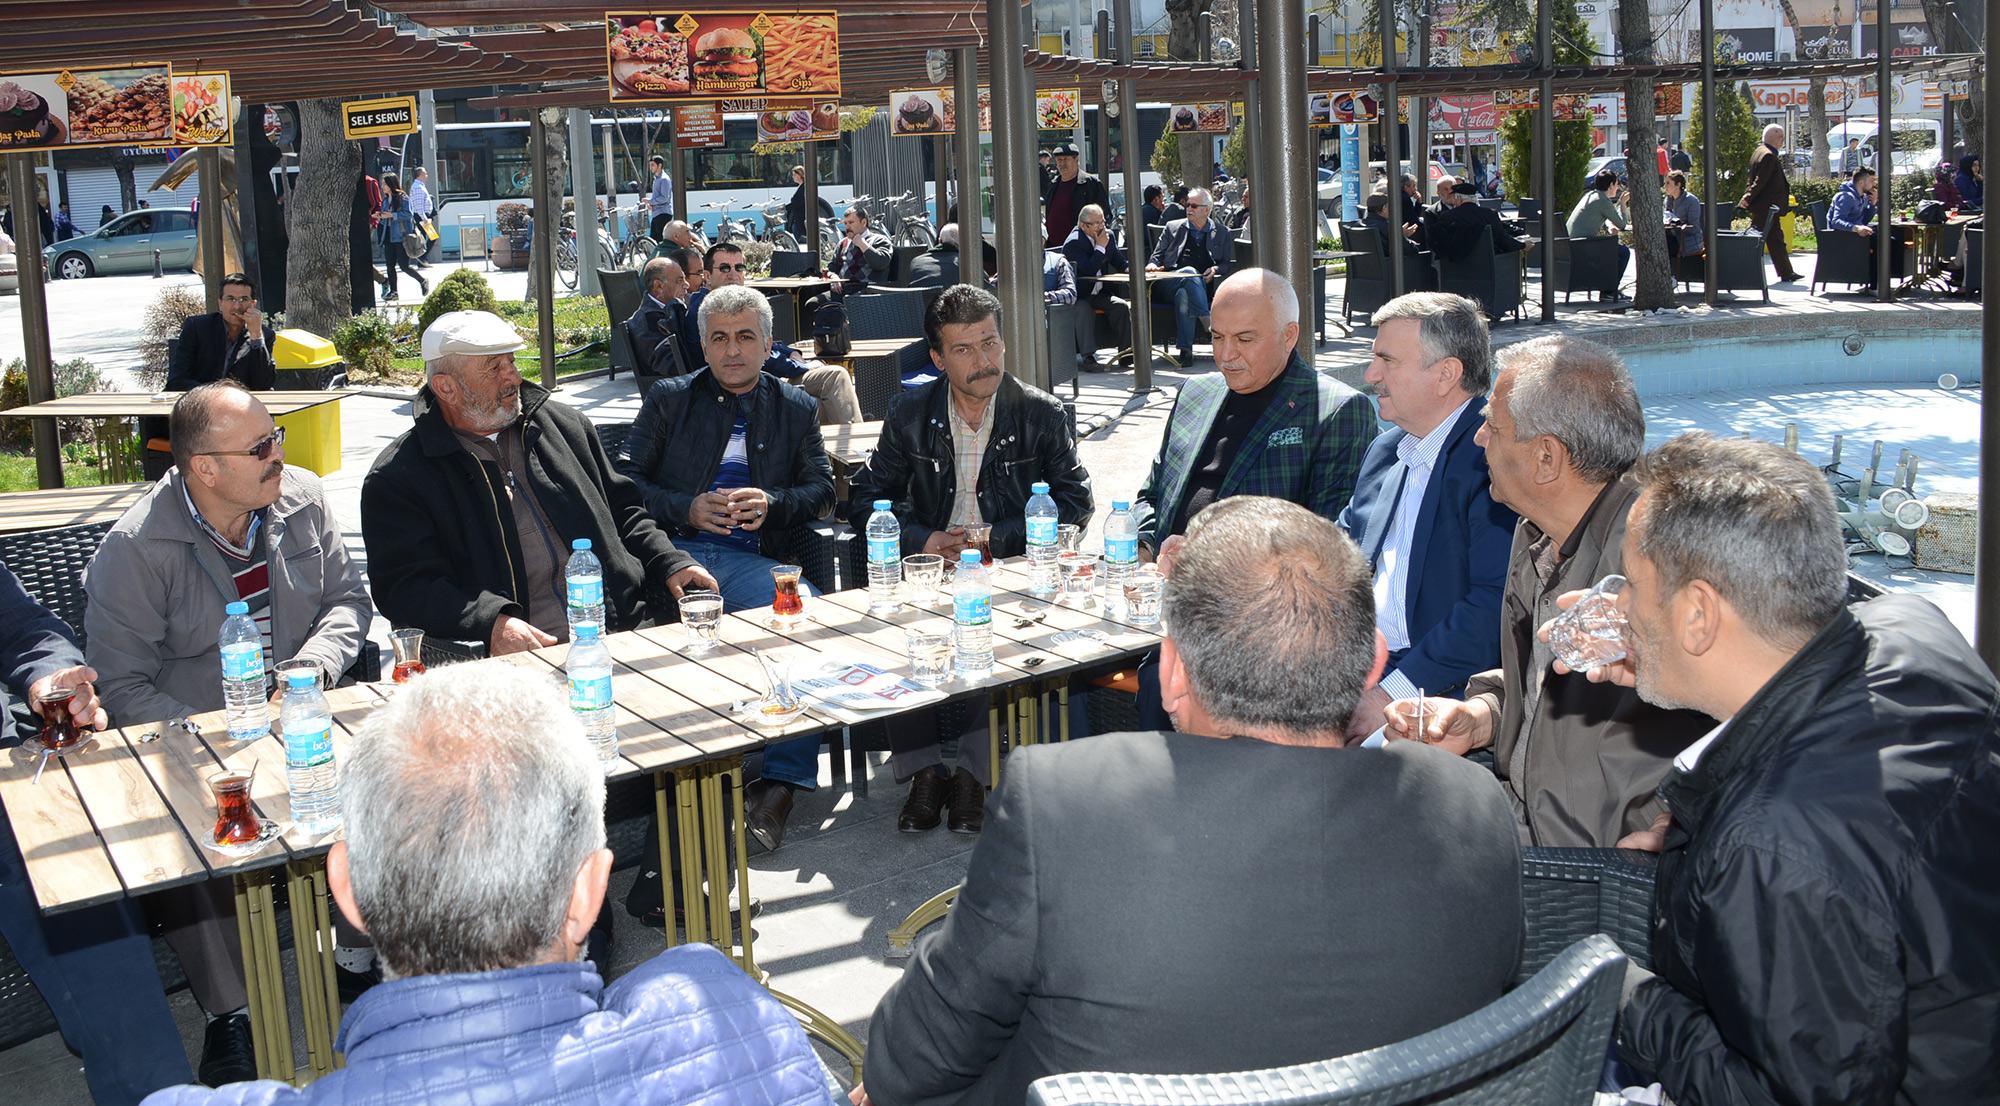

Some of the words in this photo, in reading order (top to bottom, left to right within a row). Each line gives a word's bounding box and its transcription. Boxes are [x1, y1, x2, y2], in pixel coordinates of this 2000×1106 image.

[1738, 51, 1773, 62] HOME
[634, 80, 667, 93] Pizza
[696, 79, 757, 91] Hamburger
[791, 78, 813, 89] Cips
[1752, 88, 1845, 109] Kaplaar
[721, 98, 768, 112] SALEP
[351, 115, 374, 126] SELF
[375, 110, 409, 124] SERVİS
[1458, 110, 1497, 128] Cca-Cola
[14, 129, 41, 140] Pasta
[93, 126, 118, 135] Kuru
[120, 124, 148, 134] Pasta
[188, 127, 225, 140] Waffle
[122, 147, 167, 156] UYUMCUL
